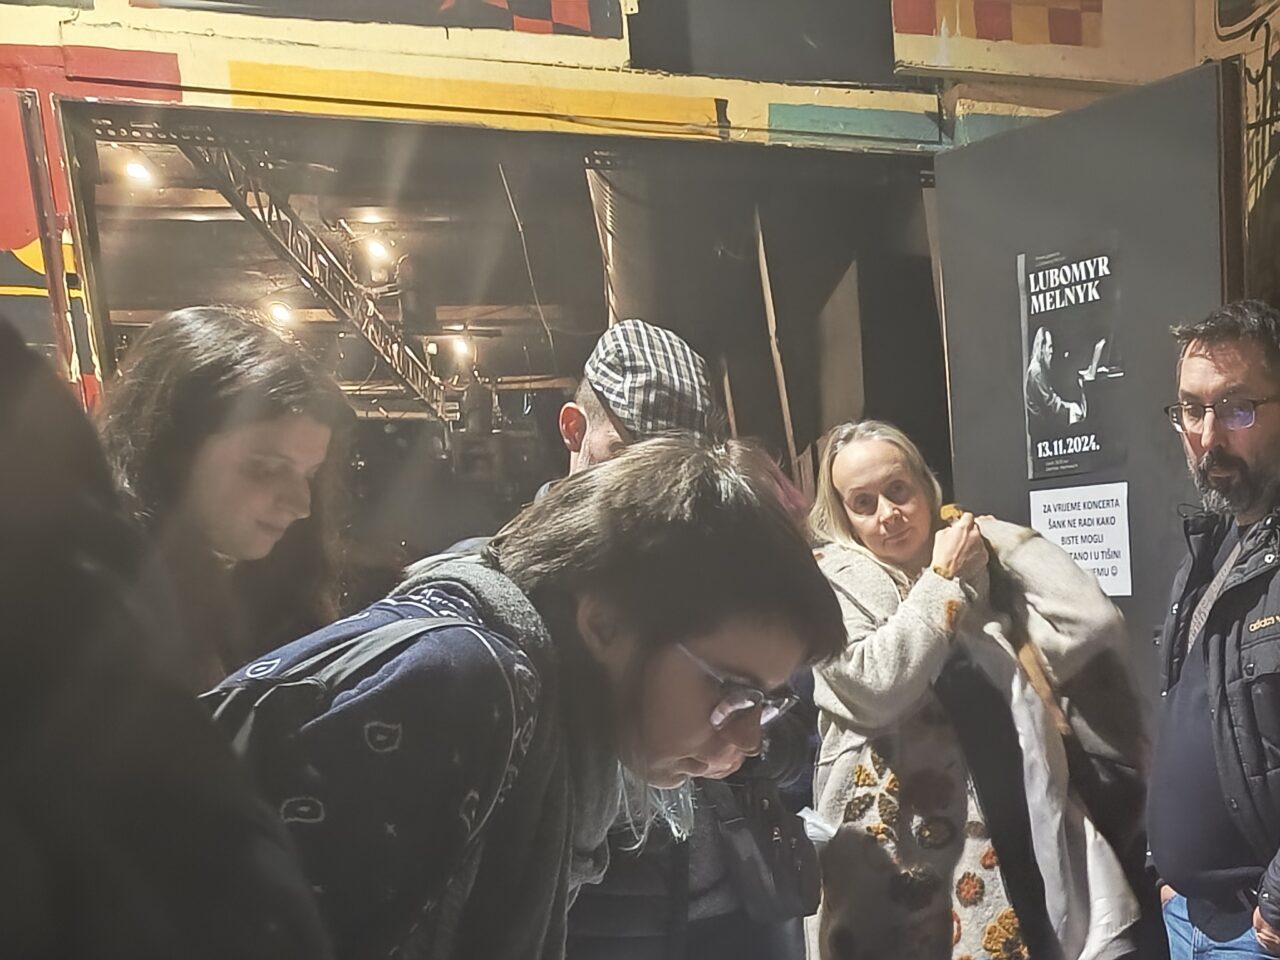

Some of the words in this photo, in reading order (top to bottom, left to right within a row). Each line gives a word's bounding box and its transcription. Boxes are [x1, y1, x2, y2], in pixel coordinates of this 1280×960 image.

[1029, 255, 1111, 293] LUBOMYR
[1030, 280, 1100, 315] MELNYK
[1037, 434, 1100, 458] 13.11.2024.
[1043, 504, 1052, 513] ZA
[1083, 498, 1120, 510] KONCERTA
[1048, 518, 1067, 529] ŠANK
[1068, 519, 1077, 528] NE
[1078, 517, 1095, 528] RADI
[1096, 516, 1116, 526] KAKO
[1061, 535, 1079, 546] BISTE
[1069, 552, 1089, 561] TANO
[1094, 551, 1099, 560] U
